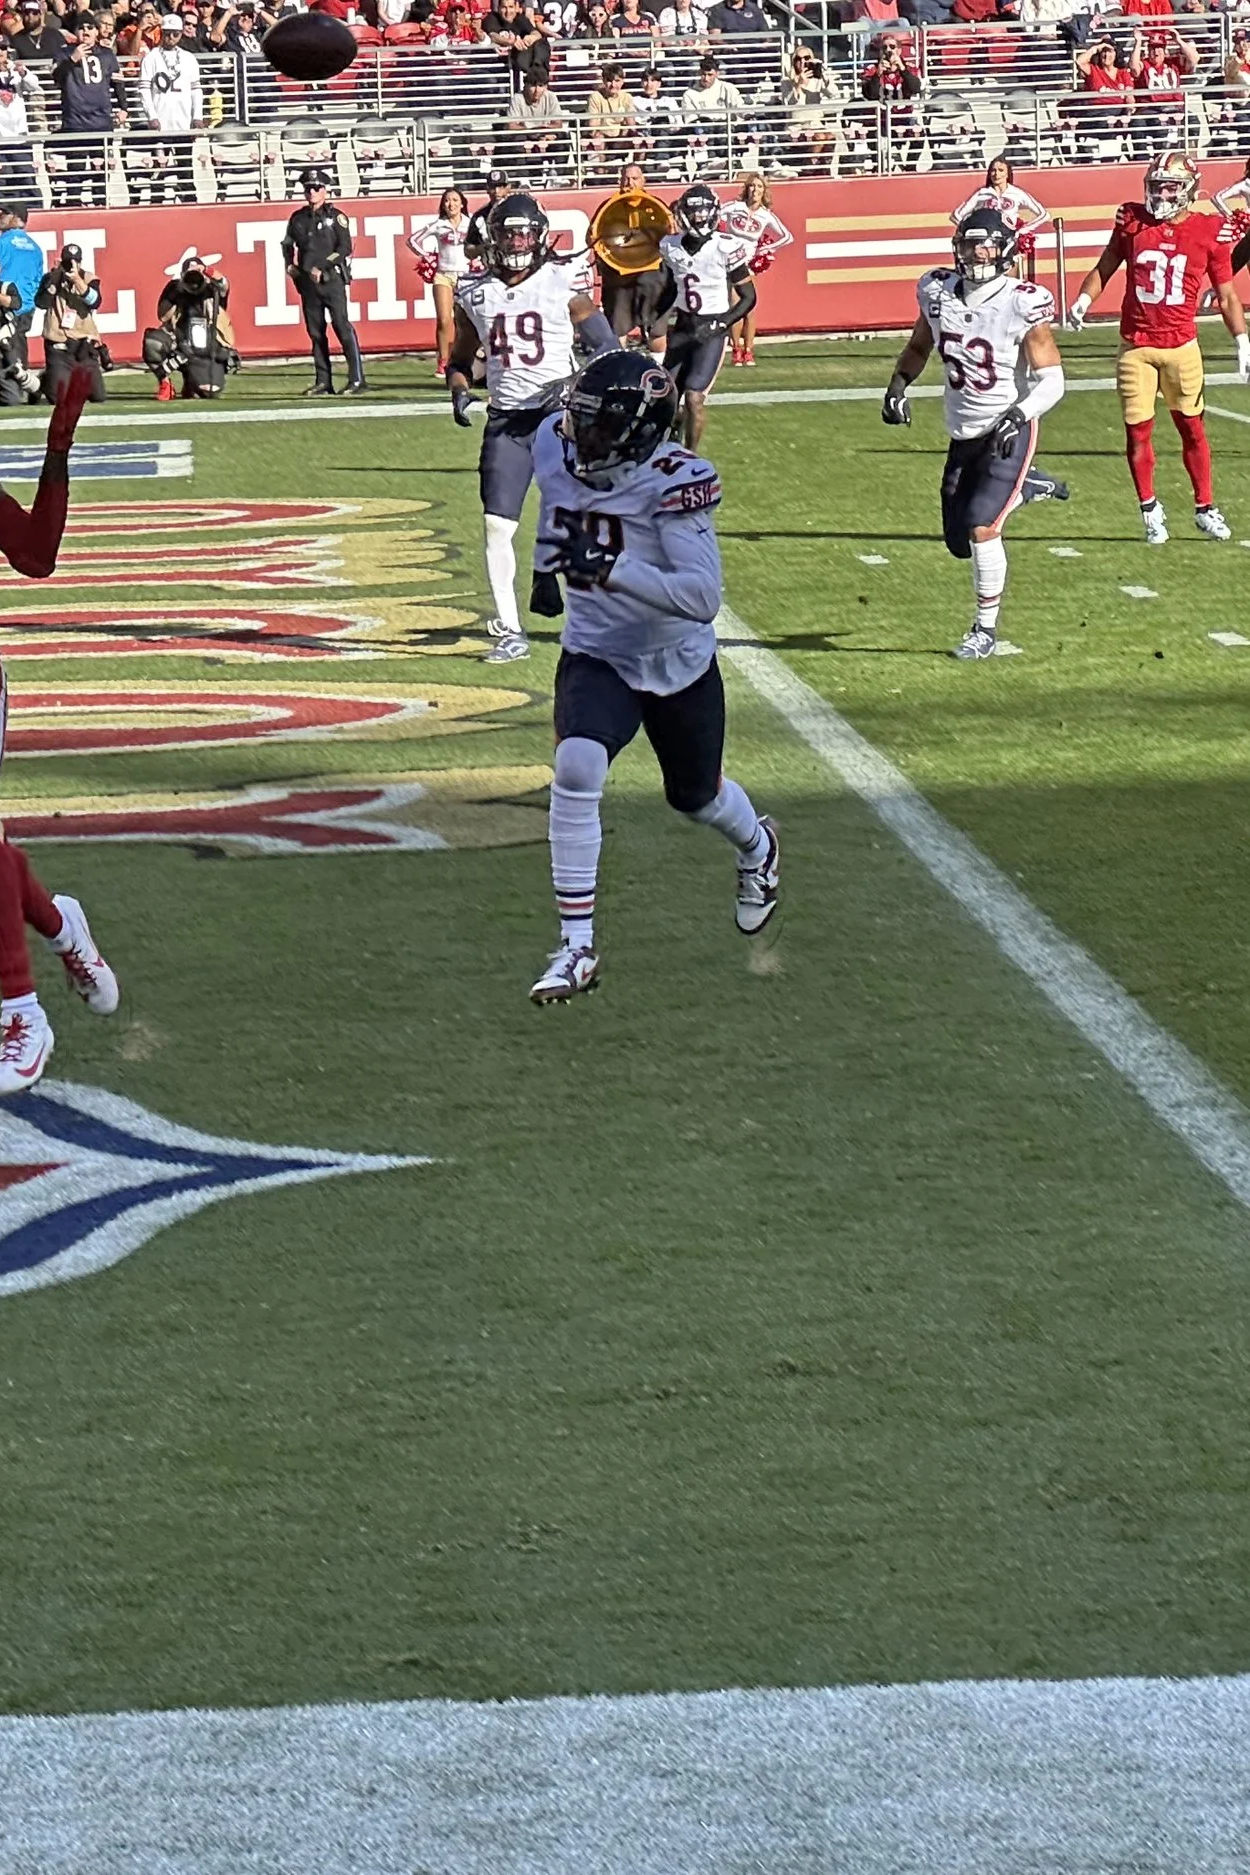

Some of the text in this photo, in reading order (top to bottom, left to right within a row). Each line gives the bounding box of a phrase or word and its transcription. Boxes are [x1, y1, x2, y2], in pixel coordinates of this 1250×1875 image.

[81, 55, 102, 84] 13
[683, 273, 703, 313] 6
[1135, 250, 1188, 306] 31
[489, 310, 545, 368] 49
[937, 332, 998, 392] 53
